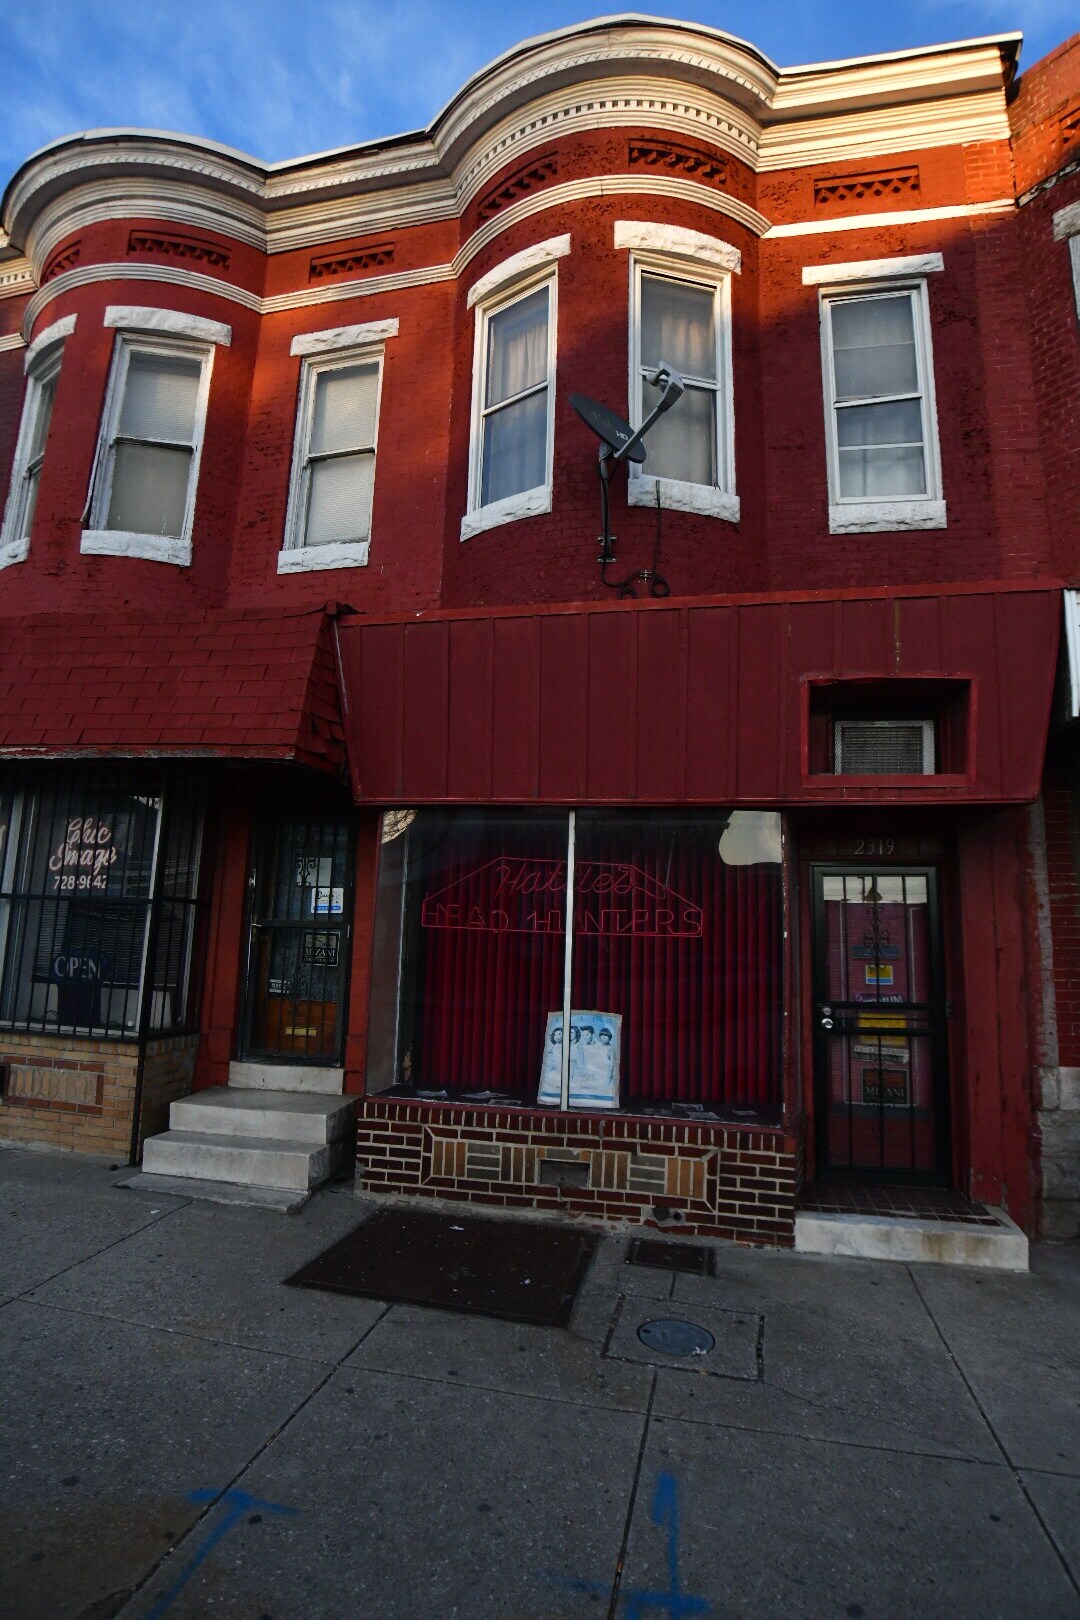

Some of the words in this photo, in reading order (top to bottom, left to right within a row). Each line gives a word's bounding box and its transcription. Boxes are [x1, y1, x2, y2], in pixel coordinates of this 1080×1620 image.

[67, 817, 112, 844] Chic
[854, 838, 895, 855] 2319
[304, 947, 336, 957] MZANI
[54, 956, 101, 980] OPEN
[865, 1086, 905, 1097] MIANI
